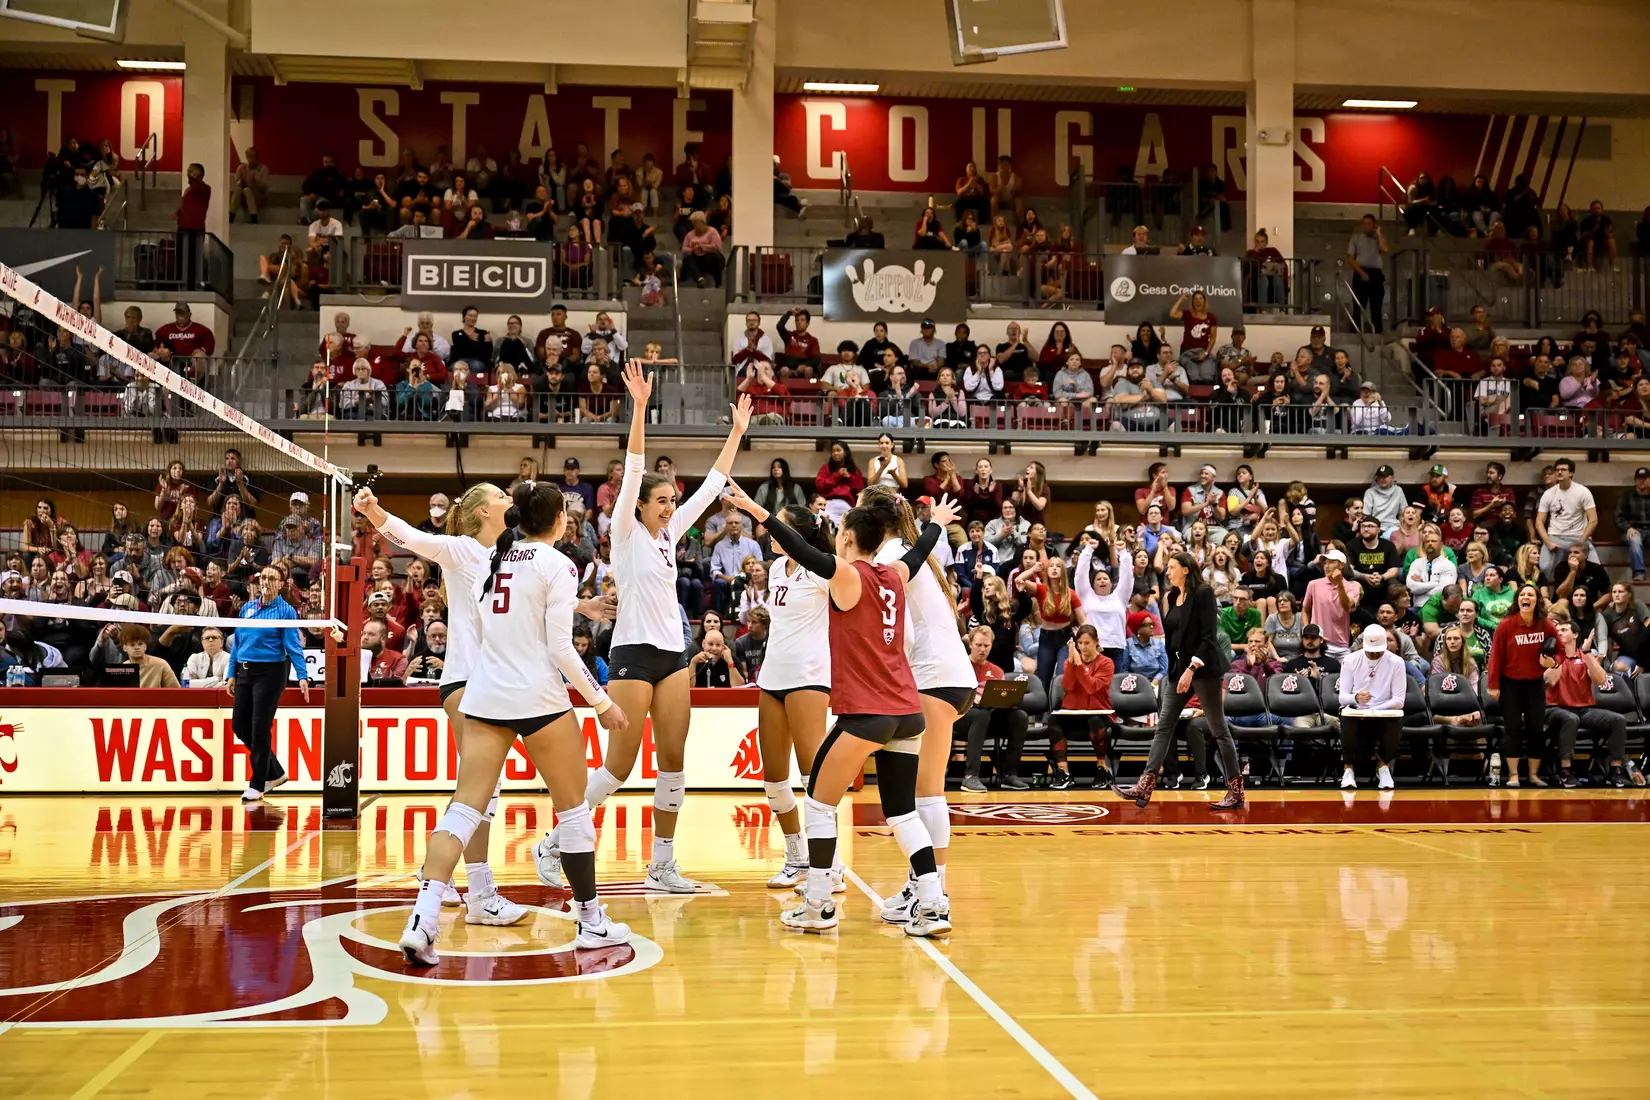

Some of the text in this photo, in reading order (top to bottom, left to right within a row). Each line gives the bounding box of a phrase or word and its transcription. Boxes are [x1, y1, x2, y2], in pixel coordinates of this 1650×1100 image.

[355, 88, 707, 176] STATE
[800, 101, 1326, 194] COUGARS
[864, 273, 925, 302] ZEPPOZ
[1139, 283, 1237, 297] Gesa Credit Union
[489, 548, 537, 564] CUGARS
[492, 573, 513, 614] 5
[775, 585, 788, 607] 12
[879, 585, 897, 627] 3
[1515, 632, 1545, 645] WAZZU
